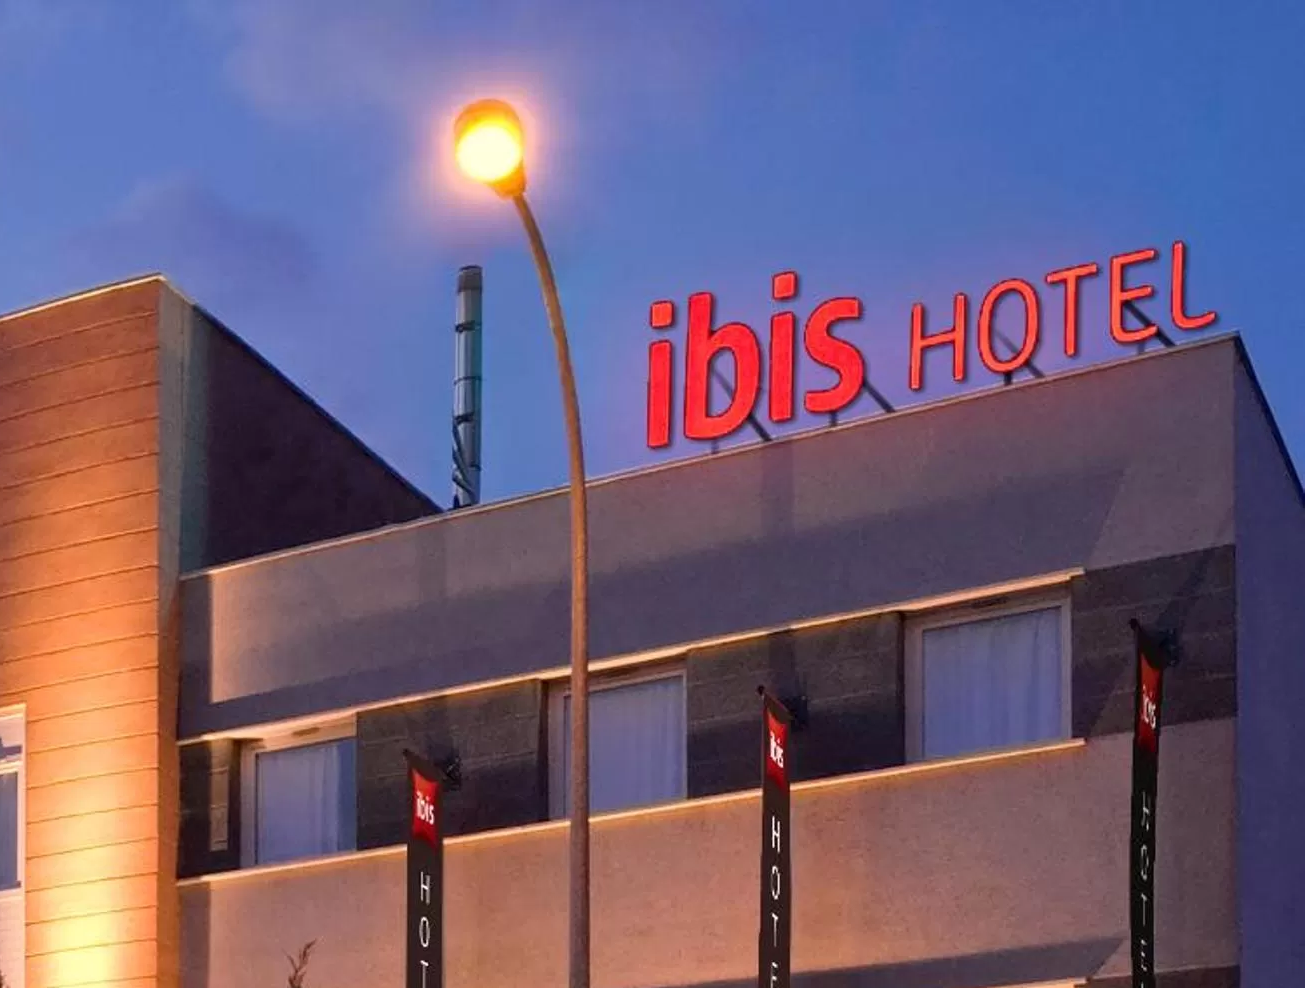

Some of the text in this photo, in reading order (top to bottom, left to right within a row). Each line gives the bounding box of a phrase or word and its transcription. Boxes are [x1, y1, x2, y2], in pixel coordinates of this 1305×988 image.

[647, 240, 1216, 448] ibis HOTEL
[415, 789, 434, 825] ibis
